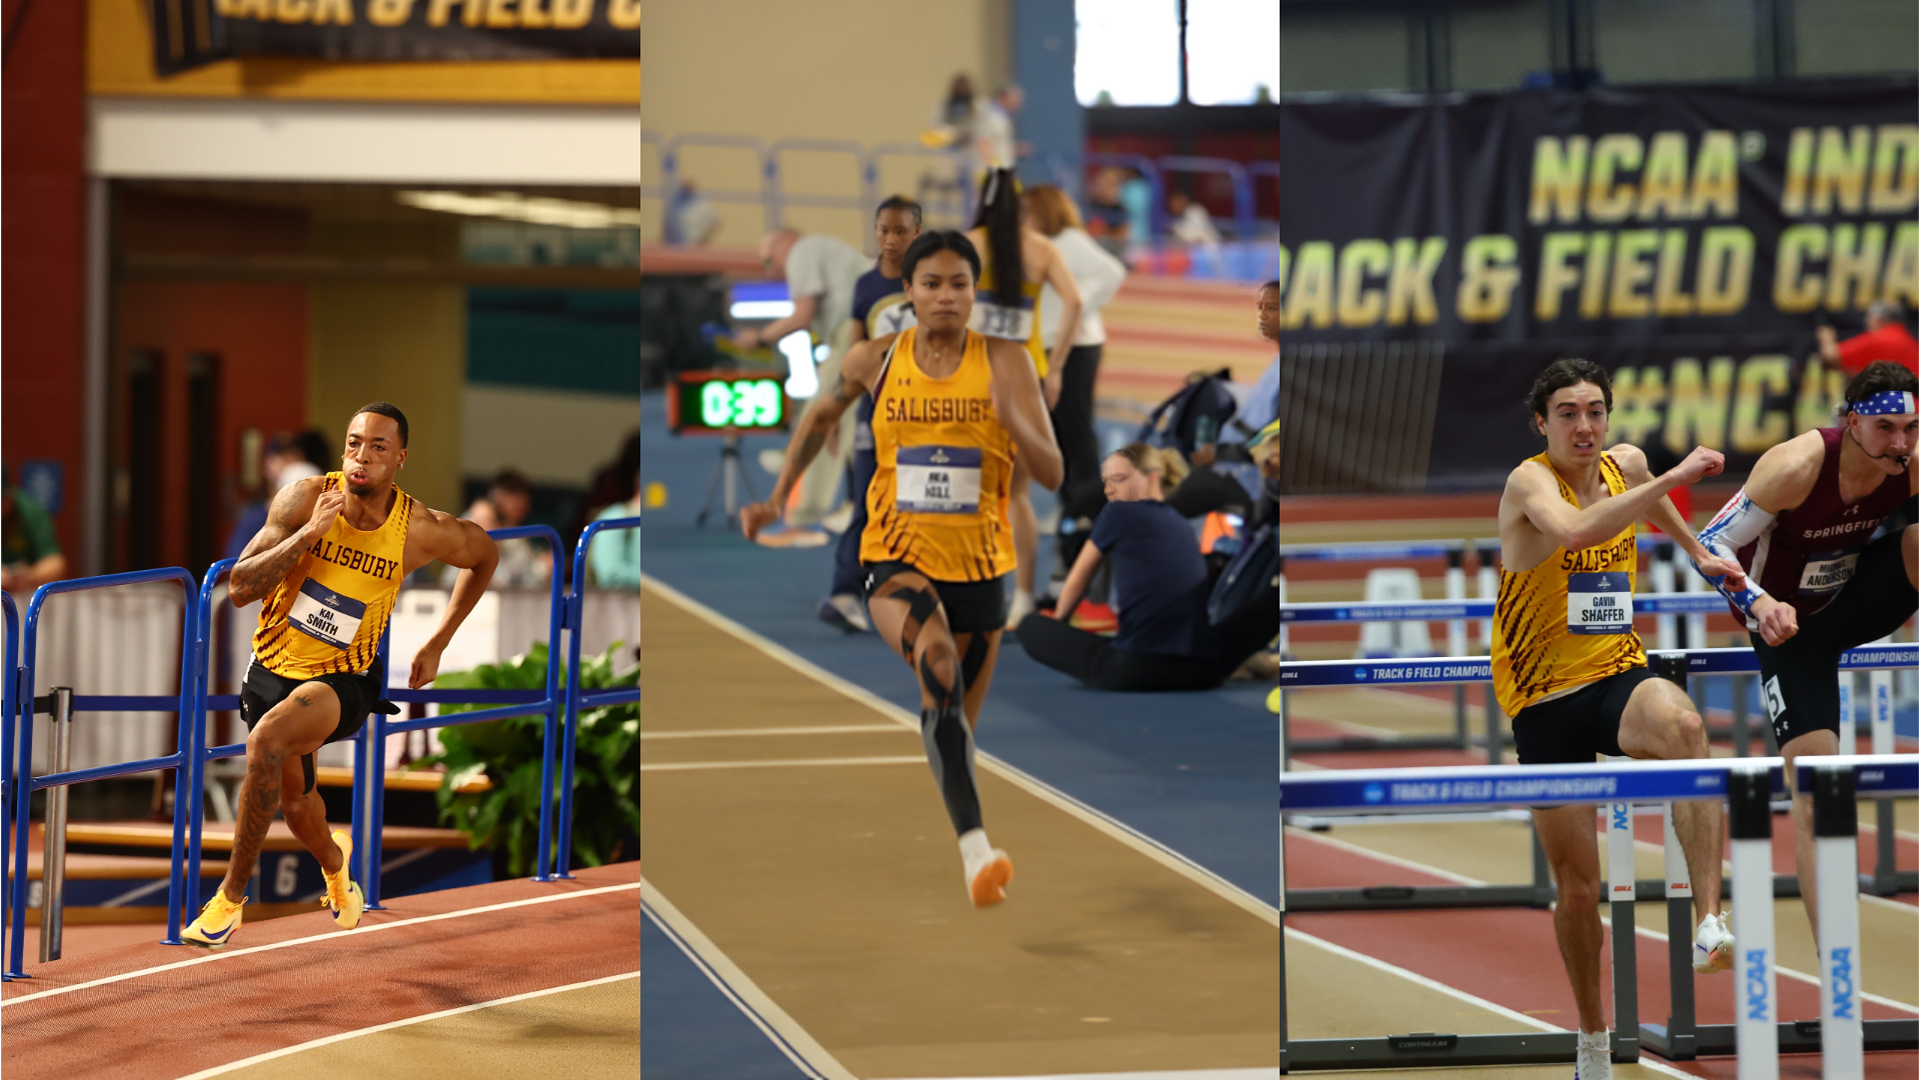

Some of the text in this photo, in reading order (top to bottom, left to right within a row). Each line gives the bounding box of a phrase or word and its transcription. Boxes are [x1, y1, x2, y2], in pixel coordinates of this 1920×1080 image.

[1781, 126, 1919, 216] IND
[1280, 222, 1919, 330] ACK & FIELD CHA
[702, 379, 782, 427] 0:39
[307, 538, 399, 580] ALISBURY
[319, 608, 335, 621] KAI
[1582, 608, 1625, 622] SHAFFER
[1593, 596, 1616, 606] GAVIN
[307, 613, 339, 636] SMITH
[1373, 668, 1405, 680] TRACK
[1405, 668, 1412, 678] &
[1414, 667, 1441, 679] FIELD
[1766, 679, 1779, 717] 5
[1495, 777, 1617, 798] CHAMPIONSHIPS
[274, 854, 299, 897] 6
[1746, 948, 1769, 1022] NCAA
[1831, 946, 1854, 1020] NCAA
